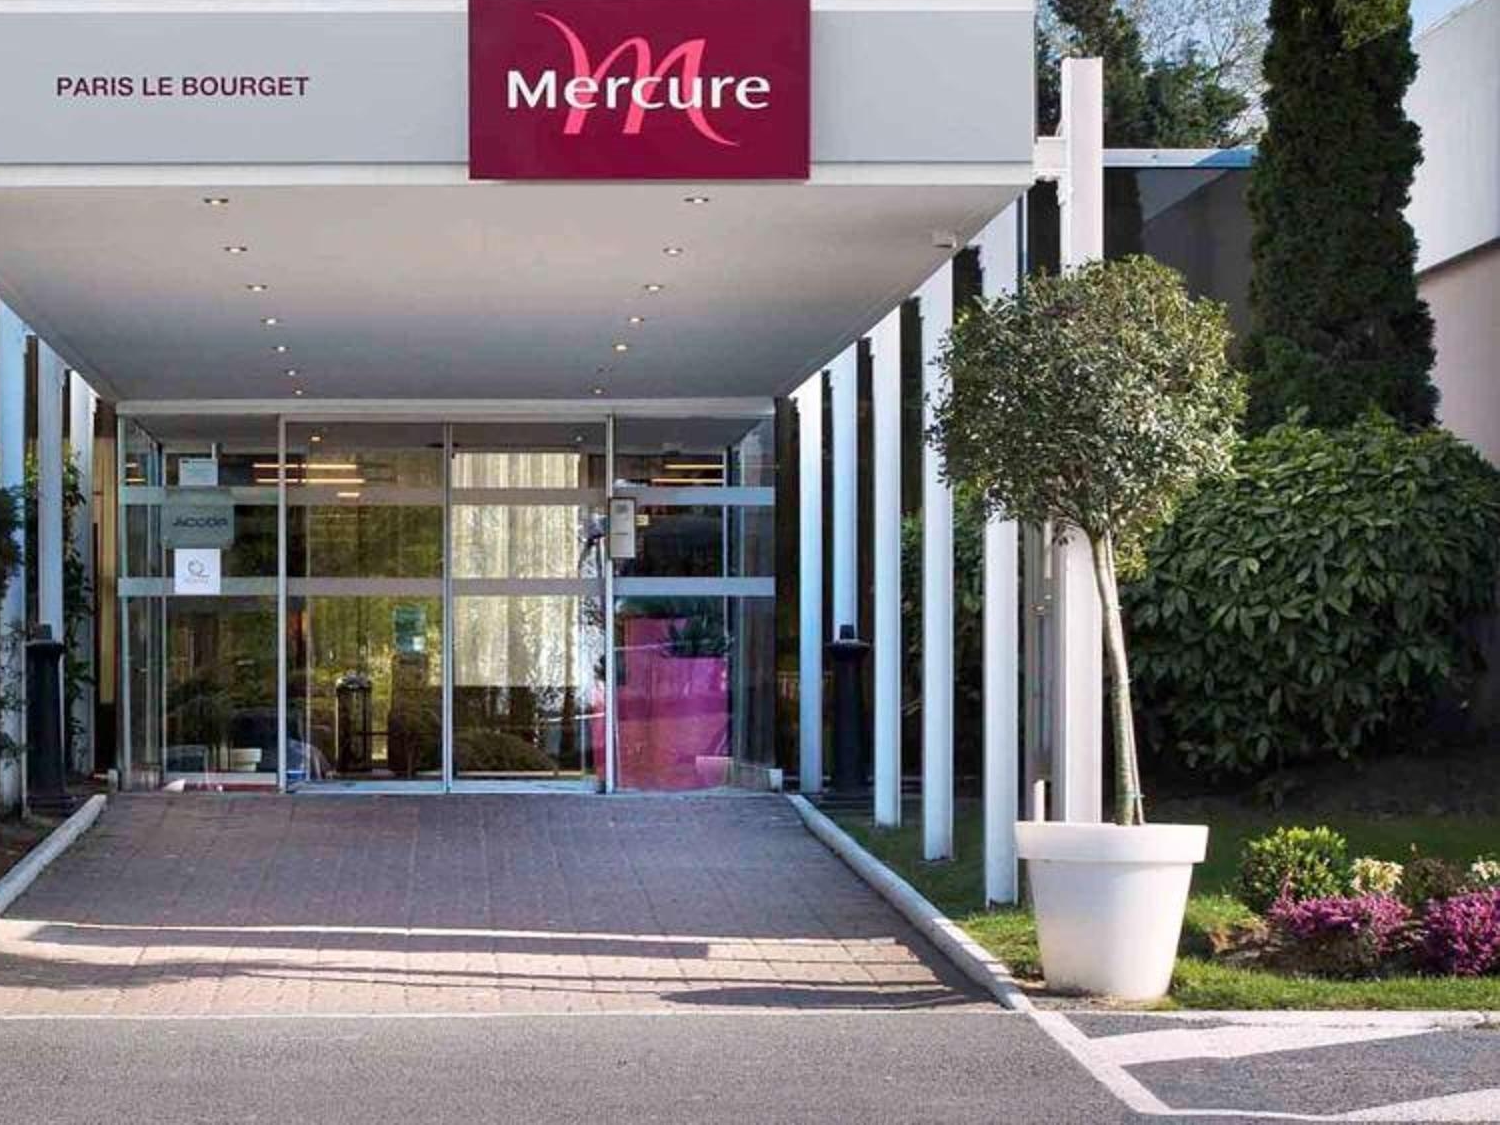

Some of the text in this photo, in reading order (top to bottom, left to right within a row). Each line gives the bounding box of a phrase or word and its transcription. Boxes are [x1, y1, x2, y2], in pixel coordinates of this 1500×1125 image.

[56, 76, 309, 97] PARIS LE BOURGET
[506, 70, 771, 109] Mercure
